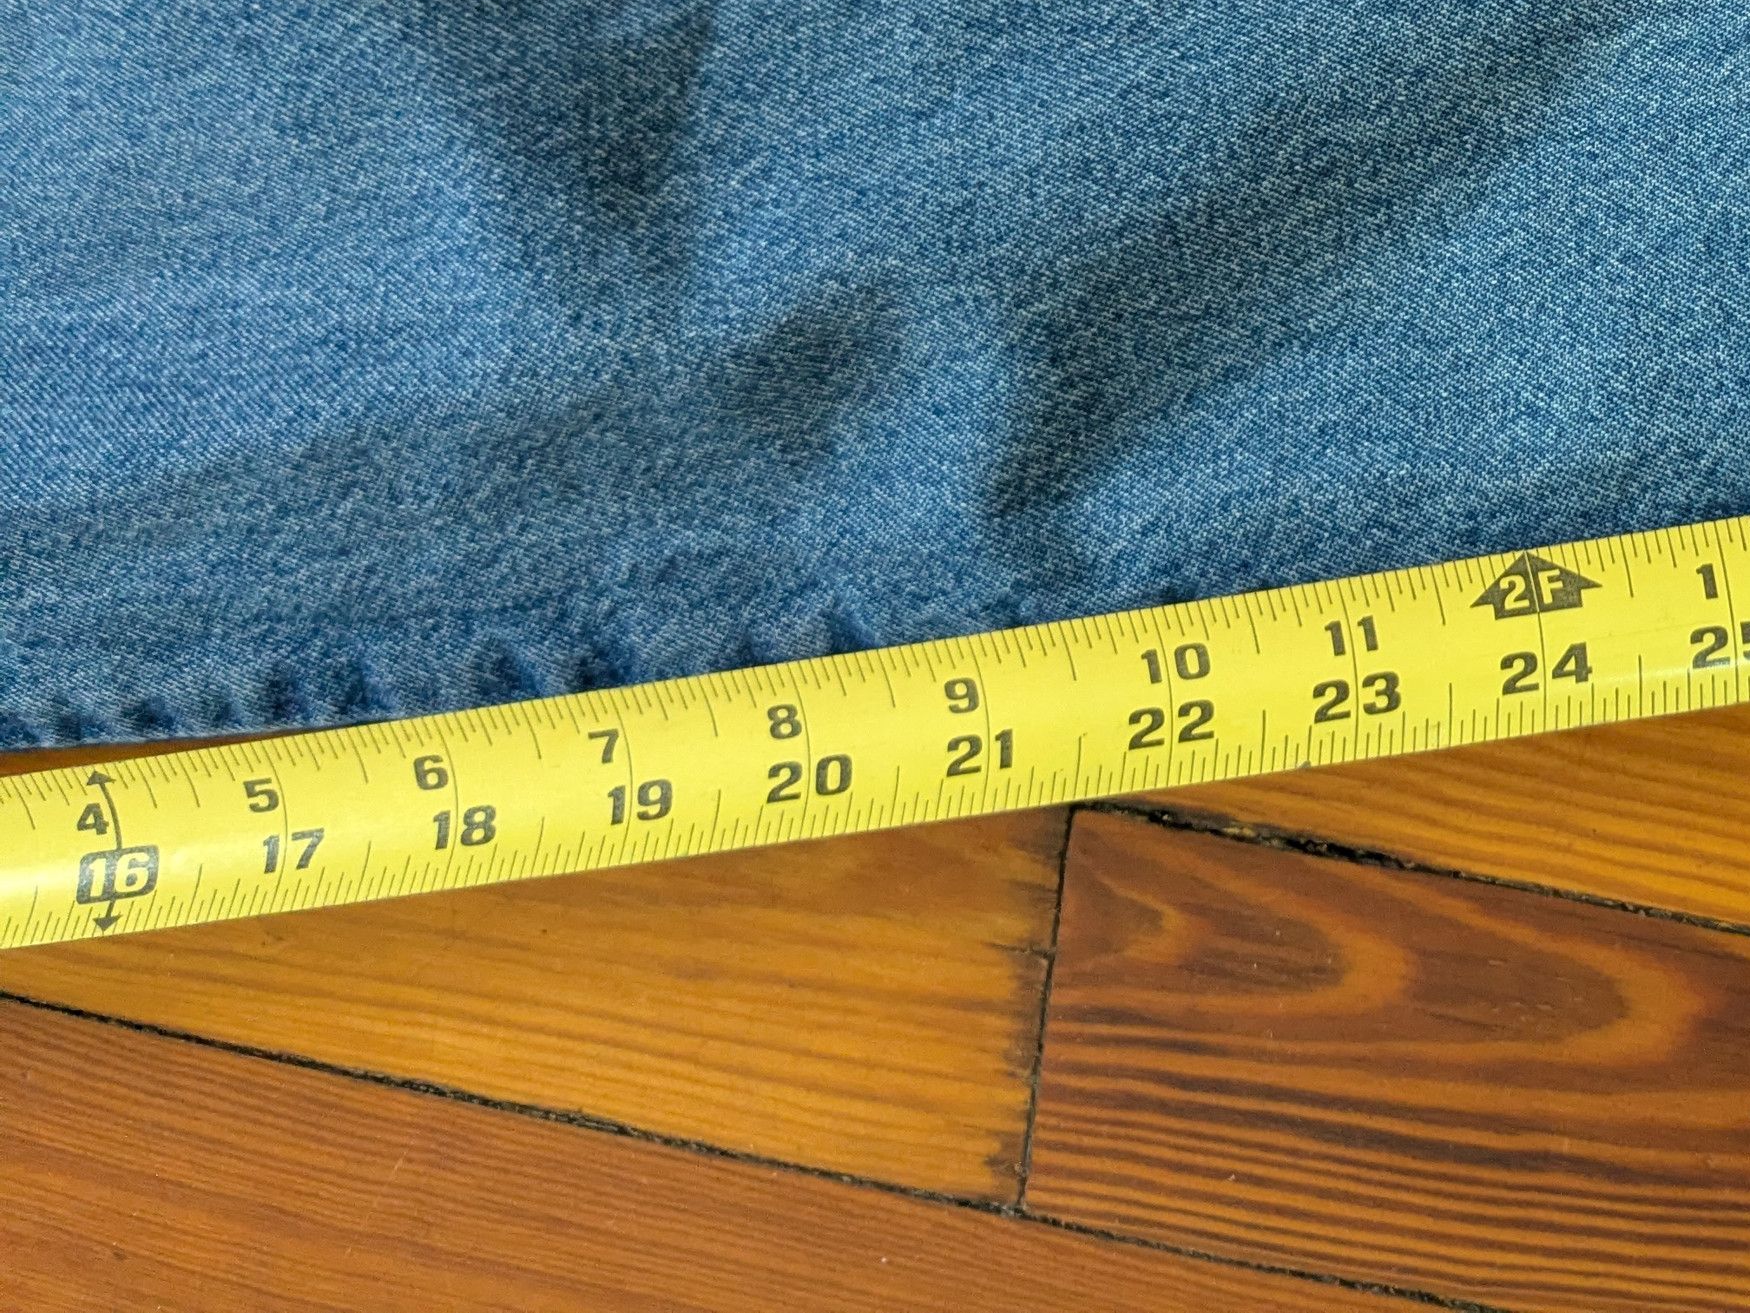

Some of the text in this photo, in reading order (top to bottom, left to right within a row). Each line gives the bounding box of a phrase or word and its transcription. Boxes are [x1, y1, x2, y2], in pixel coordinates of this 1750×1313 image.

[76, 802, 109, 837] 4
[243, 778, 280, 814] 5
[413, 755, 449, 790] 6
[588, 729, 620, 764] 7
[767, 704, 802, 740] 8
[944, 677, 980, 713] 9
[1140, 642, 1211, 684] 10
[1325, 616, 1379, 656] 11
[1499, 569, 1565, 609] 2F
[1695, 564, 1717, 600] 1
[84, 851, 152, 899] 16
[262, 828, 324, 874] 17
[432, 804, 497, 849] 18
[608, 779, 673, 825] 19
[766, 754, 853, 804] 20
[946, 729, 1014, 777] 21
[1128, 700, 1215, 750] 22
[1313, 671, 1401, 723] 23
[1500, 642, 1592, 694] 24
